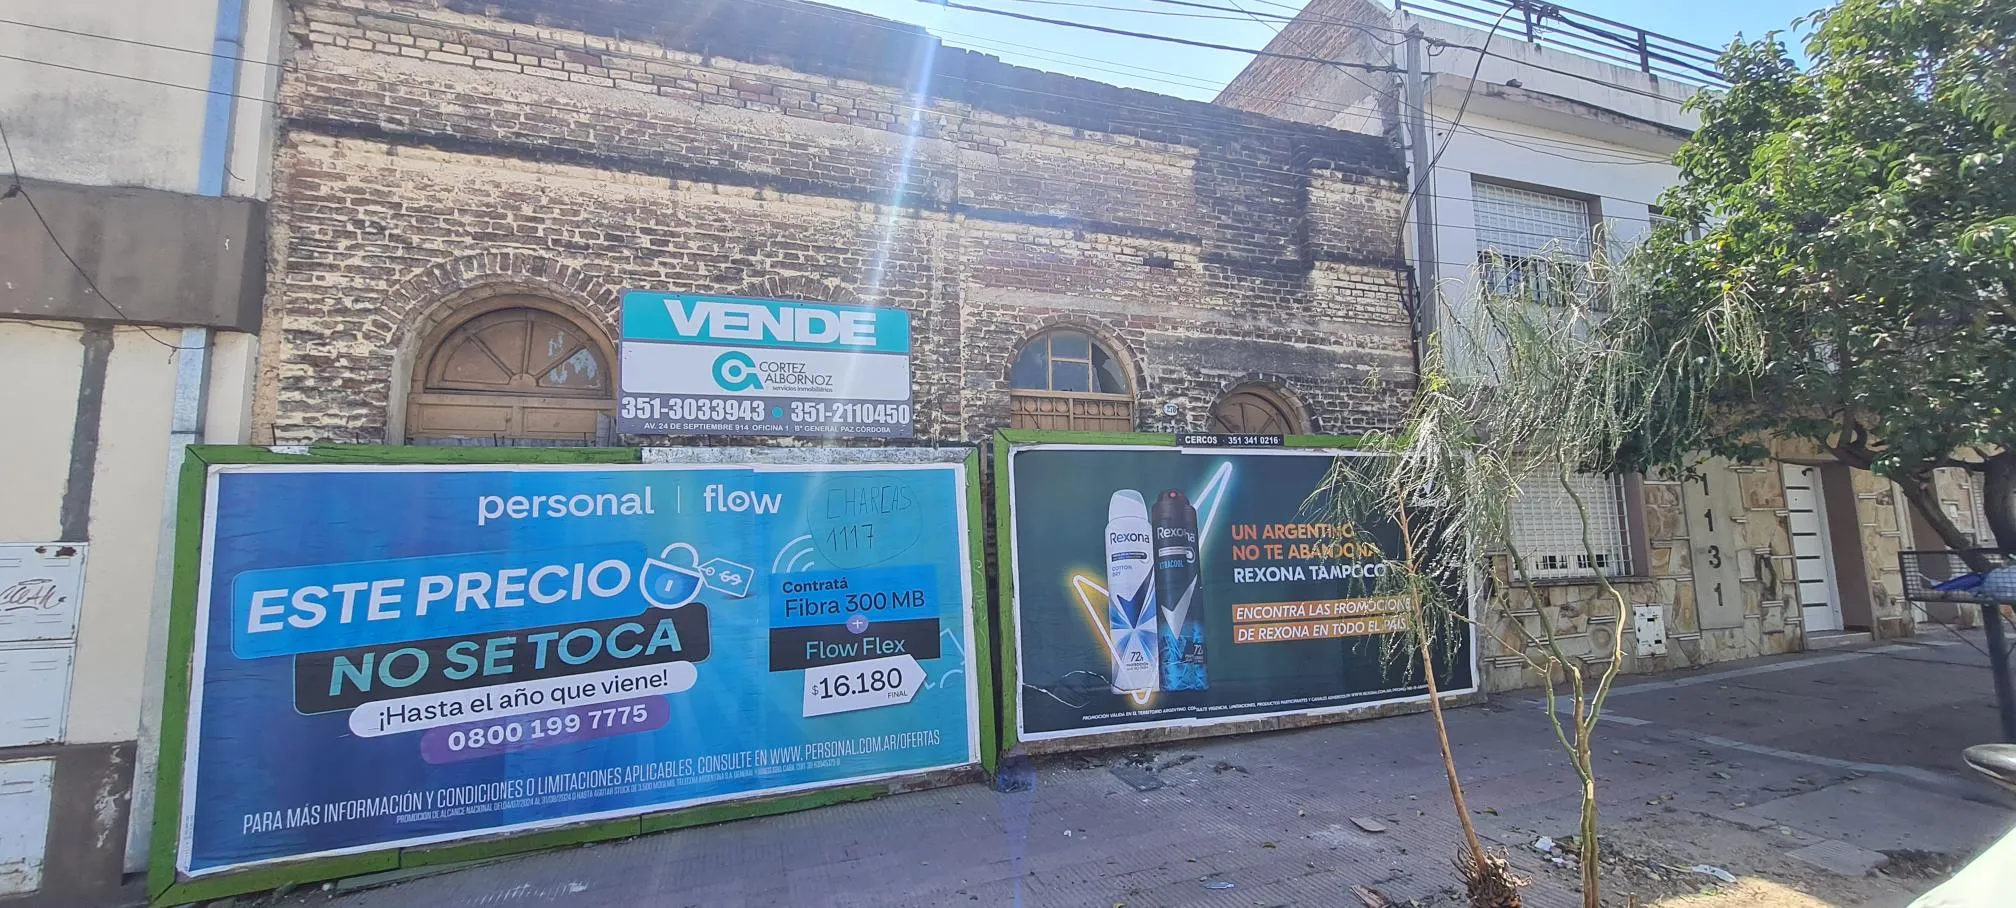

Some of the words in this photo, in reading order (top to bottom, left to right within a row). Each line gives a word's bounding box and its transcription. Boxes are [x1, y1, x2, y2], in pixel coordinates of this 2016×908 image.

[663, 299, 877, 346] VENDE
[759, 361, 806, 374] CORTEZ
[764, 373, 833, 386] ALBORNOZ
[621, 397, 765, 422] 351-3033943
[790, 401, 910, 425] 351-2110450
[644, 422, 657, 430] AV.
[658, 422, 669, 430] 24
[683, 423, 733, 431] SEPTIEMBRE
[735, 424, 749, 432] 914
[752, 424, 784, 432] OFICINA
[804, 425, 839, 433] GENERAL
[1185, 435, 1218, 444] CERCOS
[1227, 436, 1241, 445] 351
[1244, 436, 1258, 445] 341
[1260, 436, 1278, 445] 0216
[477, 486, 655, 526] personal
[703, 484, 783, 514] flow
[826, 485, 912, 520] CHARCAS
[826, 523, 873, 552] 1117
[1109, 532, 1150, 545] Rexona
[1157, 526, 1195, 543] Rexona
[1231, 524, 1257, 540] UN
[1232, 544, 1260, 561] NO
[1264, 544, 1283, 560] TE
[1233, 566, 1305, 584] REXONA
[1309, 563, 1387, 580] TAMPOCO
[247, 578, 405, 633] ESTE
[416, 559, 631, 617] PRECIO
[782, 577, 849, 594] Contratá
[785, 597, 840, 618] Fibra
[845, 592, 887, 613] 300
[892, 590, 925, 609] MB
[1236, 603, 1306, 620] ENCONTRÁ
[1309, 603, 1330, 616] LAS
[1238, 629, 1255, 641] DE
[1258, 626, 1309, 640] REXONA
[1313, 624, 1329, 636] EN
[1332, 621, 1365, 635] TODO
[1368, 620, 1380, 632] EL
[329, 647, 429, 697] NO
[442, 636, 517, 681] SE
[527, 618, 682, 670] TOCA
[806, 640, 858, 660] Flow
[863, 636, 906, 656] Flex
[379, 699, 464, 732] ¡Hasta
[470, 693, 494, 713] el
[499, 688, 545, 708] año
[550, 683, 596, 704] que
[601, 669, 669, 694] viene!
[887, 690, 908, 699] FINAL
[448, 722, 523, 751] 0800
[531, 713, 581, 738] 199
[588, 703, 648, 729] 7775
[242, 811, 283, 835] PARA
[286, 803, 320, 829] MÁS
[324, 790, 422, 823] INFORMACIÓN
[424, 791, 435, 809] Y
[437, 779, 523, 808] CONDICIONES
[526, 777, 535, 796] O
[538, 767, 622, 795] LIMITACIONES
[697, 750, 752, 774] CONSULTE
[754, 750, 767, 767] EN
